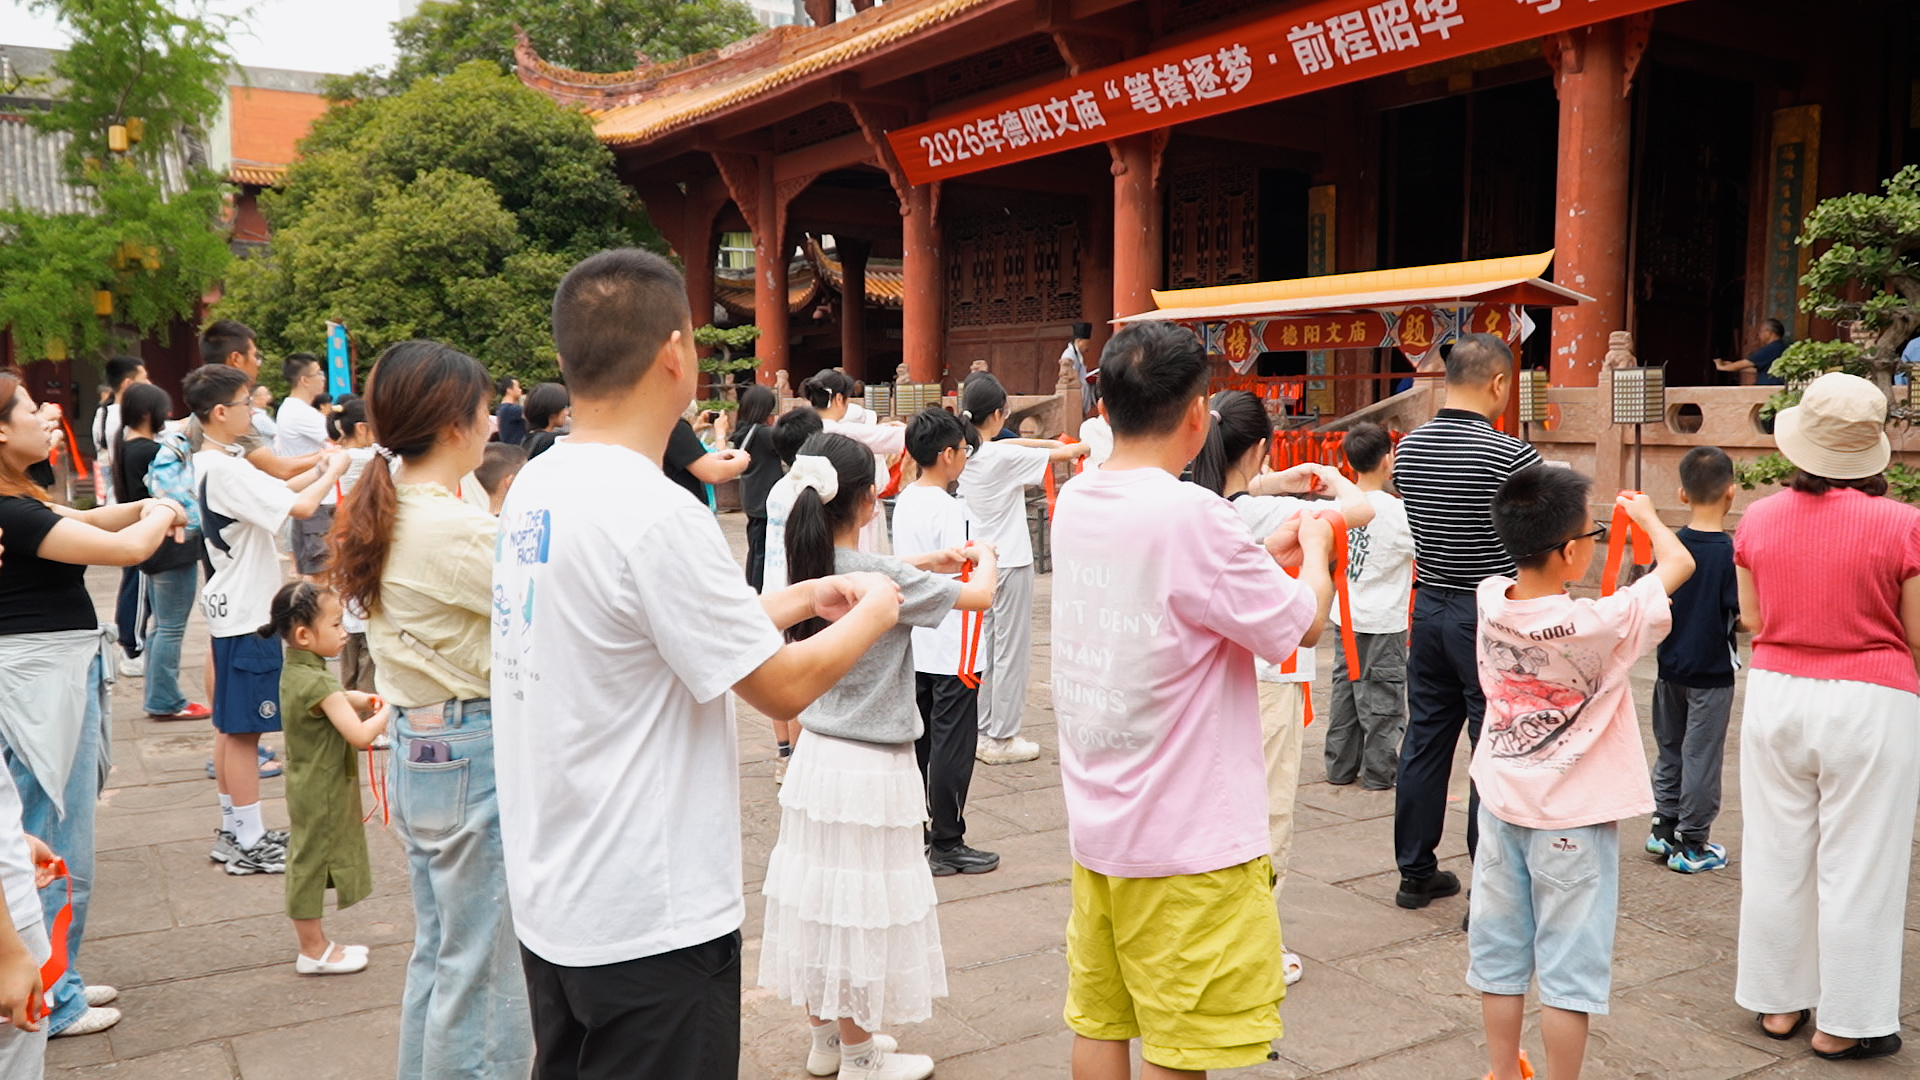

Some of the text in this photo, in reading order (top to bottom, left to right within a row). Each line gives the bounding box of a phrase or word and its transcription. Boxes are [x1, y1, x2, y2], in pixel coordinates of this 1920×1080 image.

[1227, 325, 1248, 358] 榜
[1281, 321, 1367, 346] 德阳文庙
[1401, 314, 1430, 346] 题
[1067, 560, 1110, 588] YOU
[1098, 607, 1163, 637] DENY
[1057, 641, 1115, 672] MANY
[1053, 672, 1127, 714] THINGS
[1078, 725, 1139, 749] ONCE
